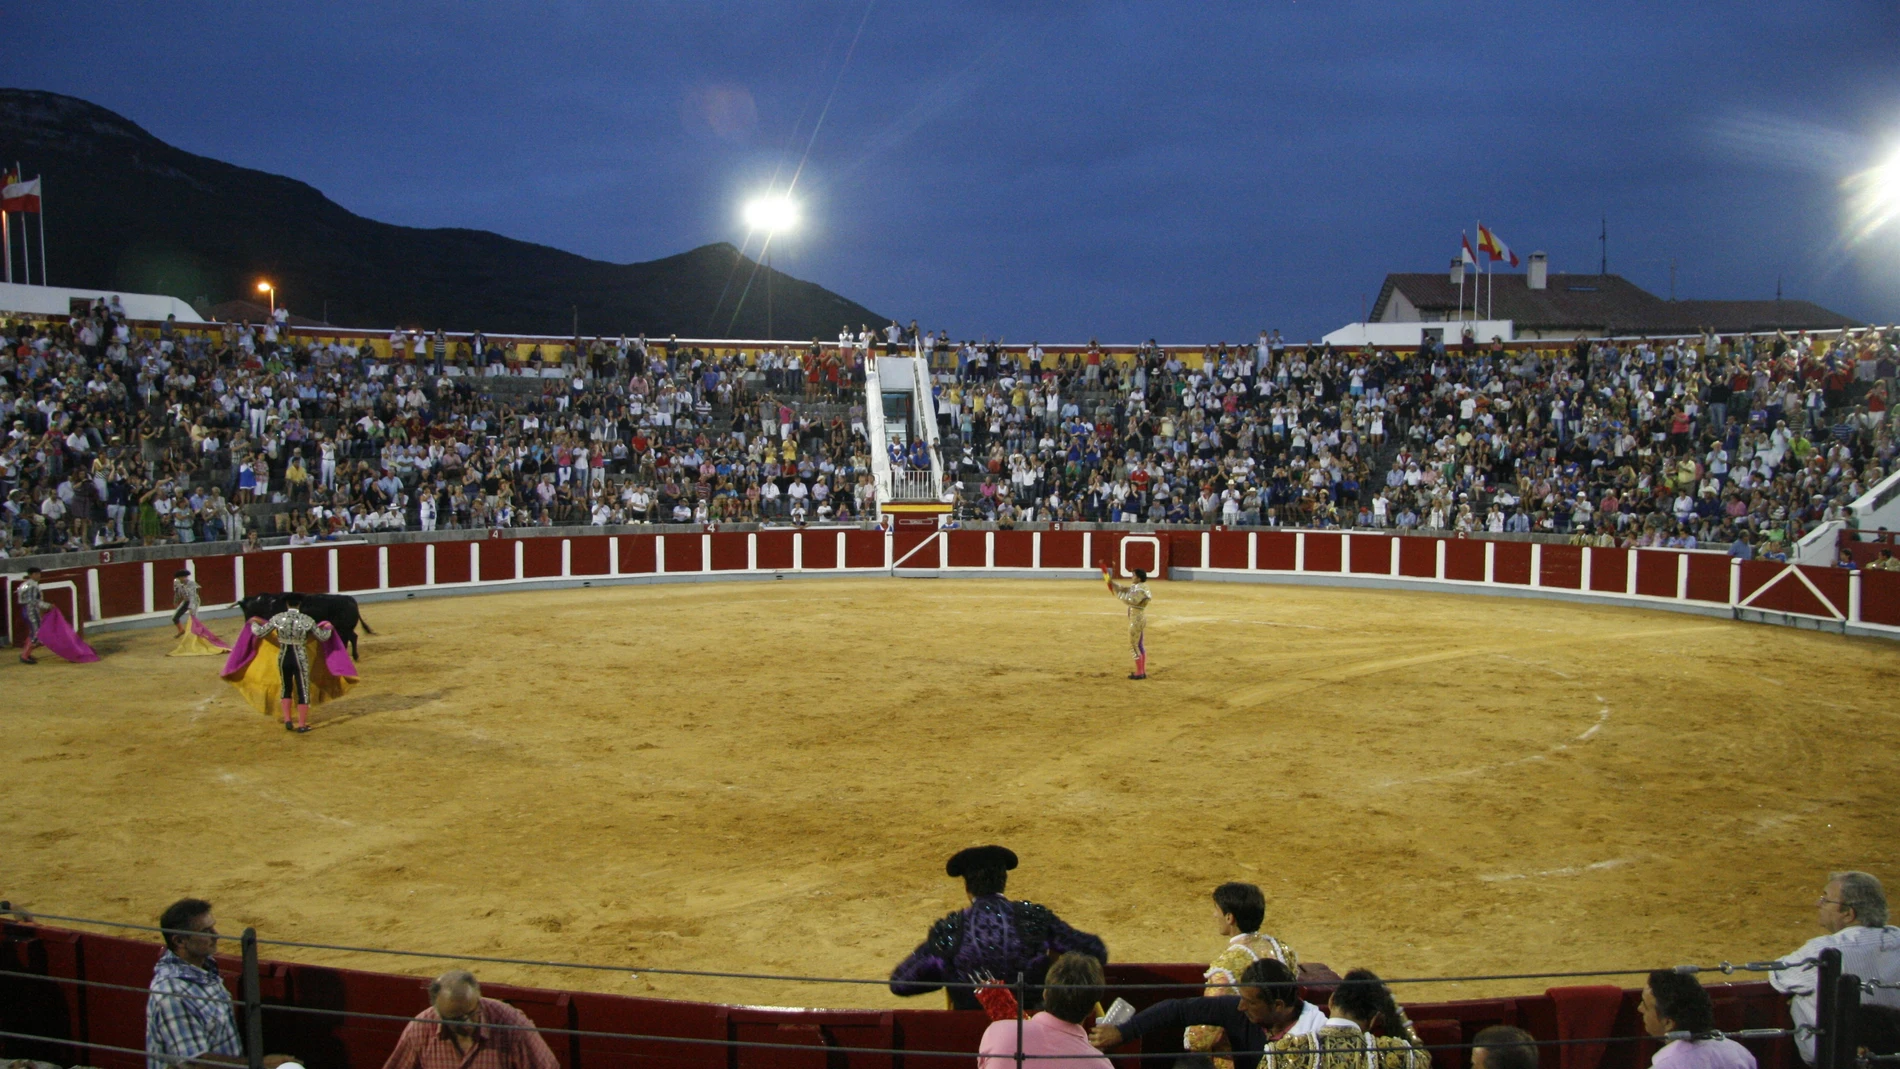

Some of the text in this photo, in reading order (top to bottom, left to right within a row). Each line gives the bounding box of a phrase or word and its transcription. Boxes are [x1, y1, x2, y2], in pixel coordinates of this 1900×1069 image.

[708, 523, 715, 533] 4
[1054, 523, 1060, 531] 5
[492, 530, 499, 538] 4
[103, 552, 111, 562] 3
